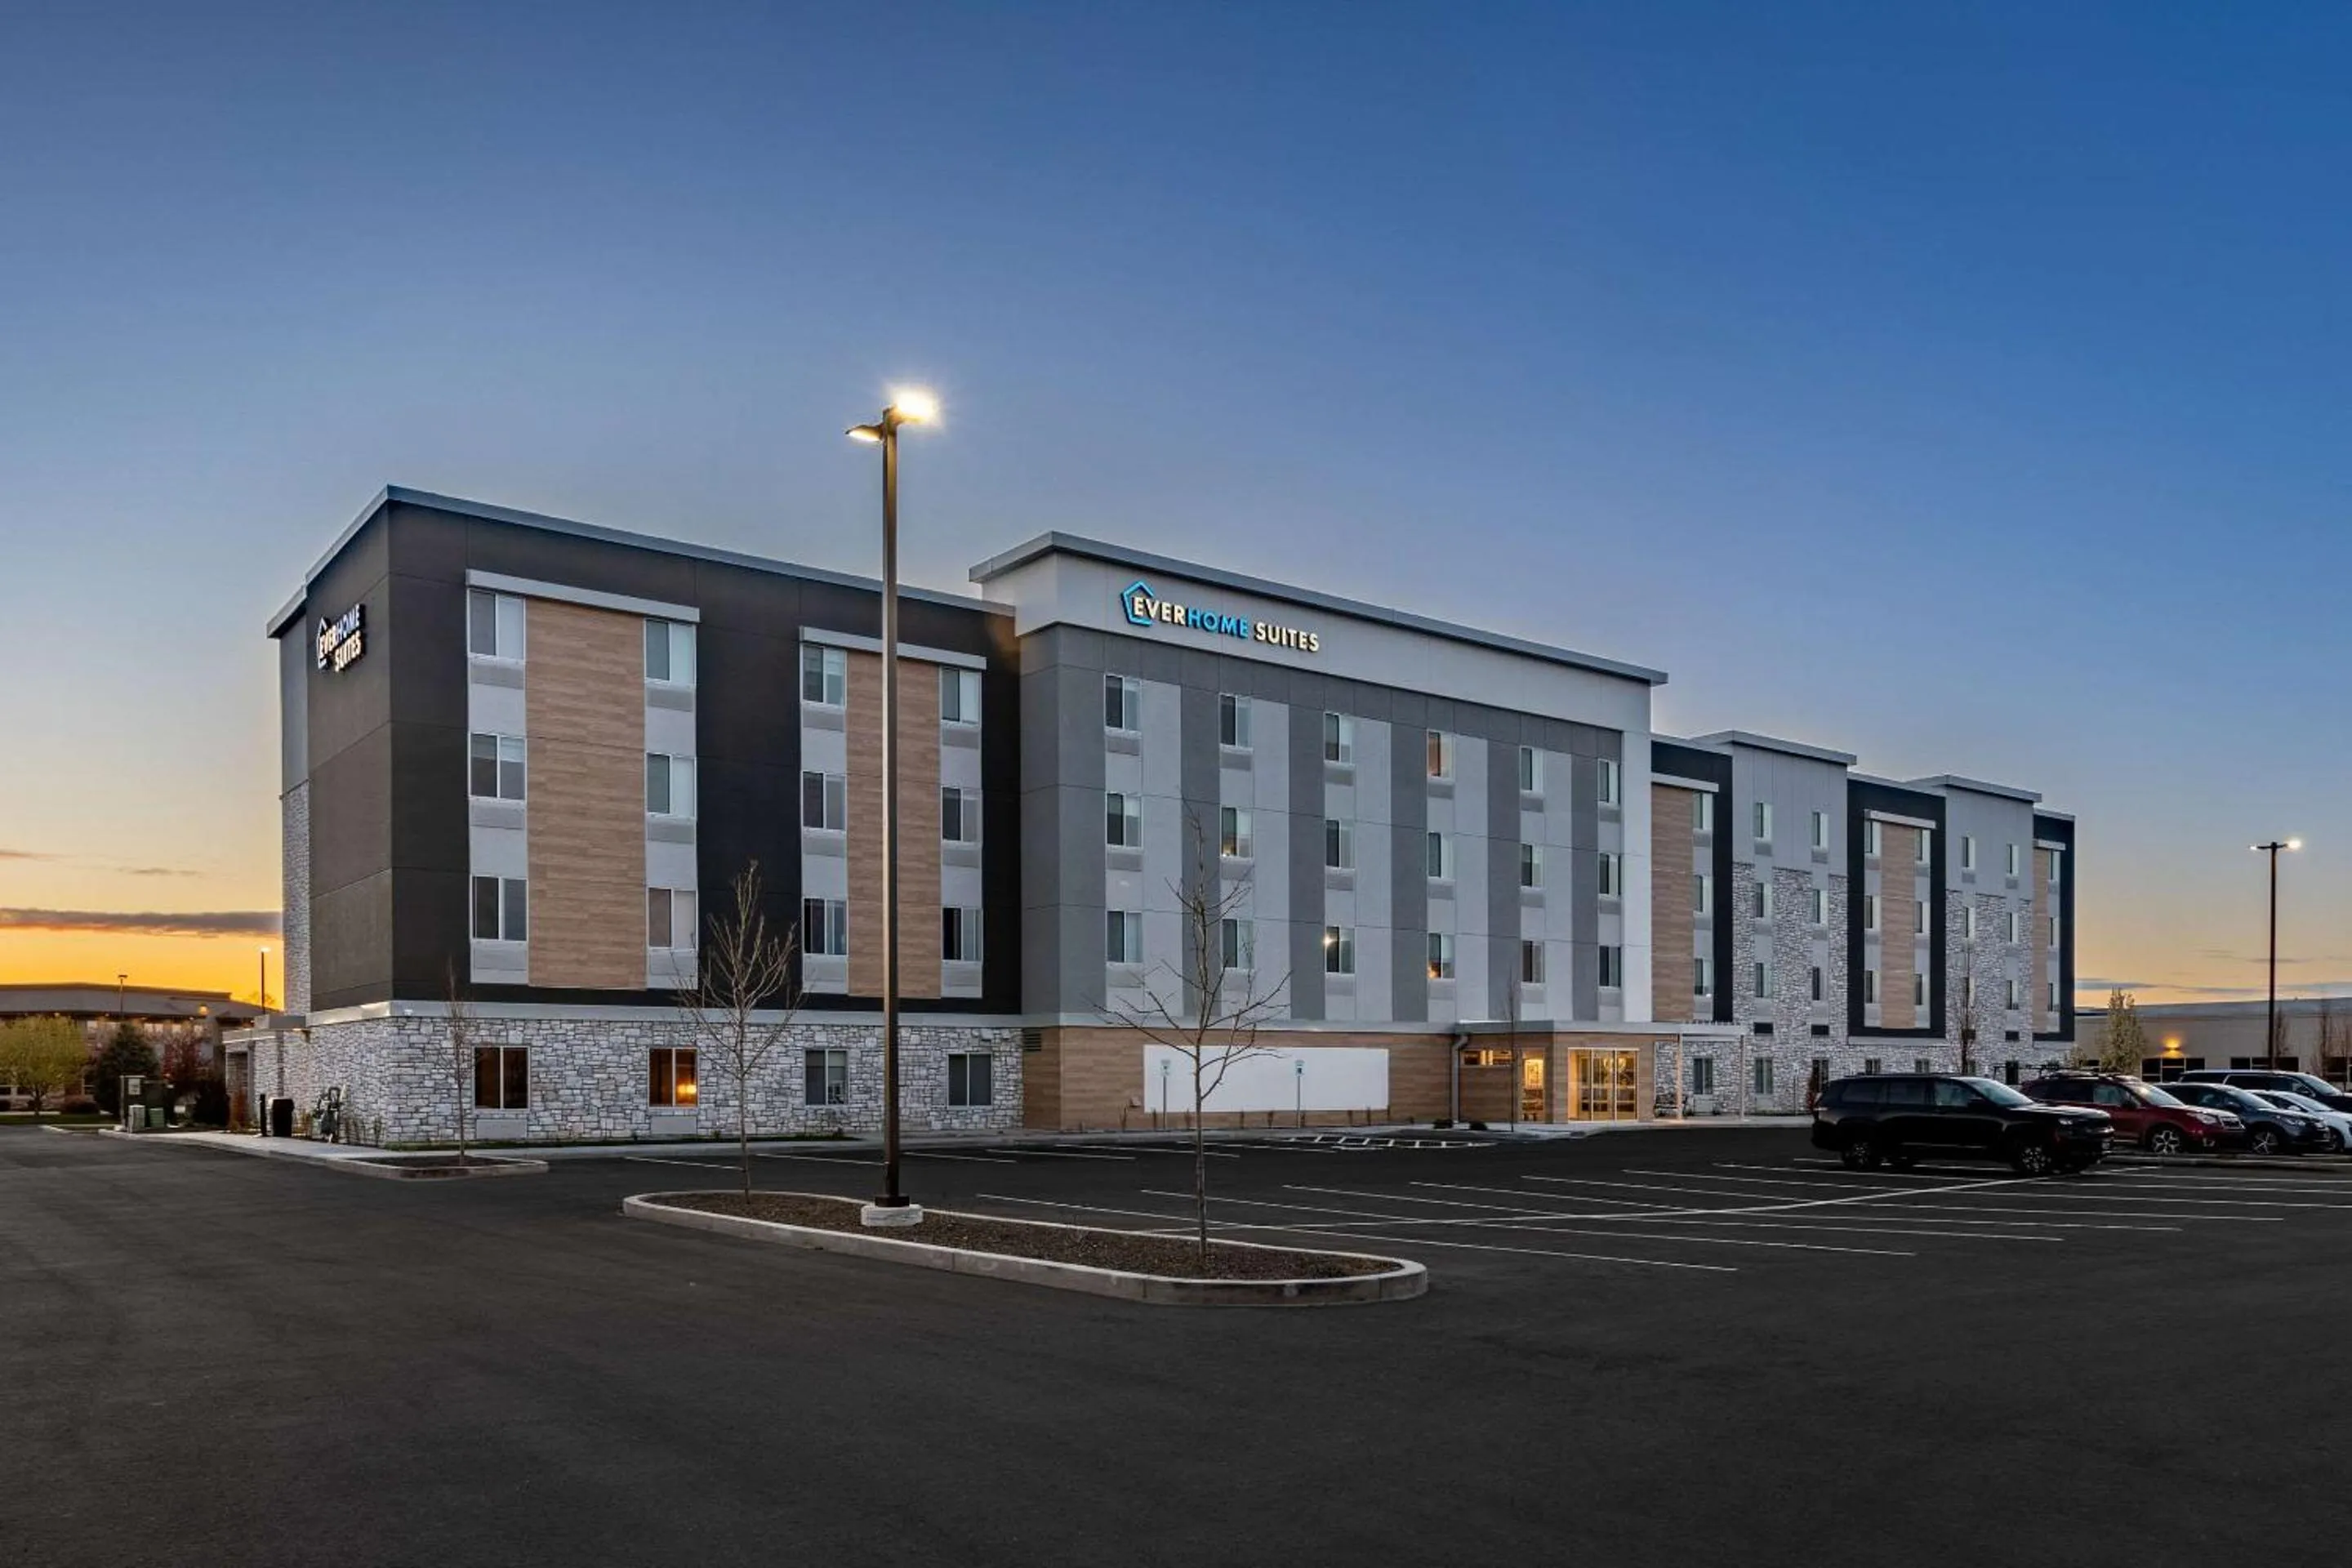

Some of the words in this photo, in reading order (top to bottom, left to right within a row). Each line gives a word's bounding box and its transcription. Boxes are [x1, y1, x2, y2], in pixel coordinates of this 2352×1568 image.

[1133, 597, 1249, 638] EVERHOME
[1255, 622, 1320, 653] SUITES
[335, 630, 362, 672] SUITES
